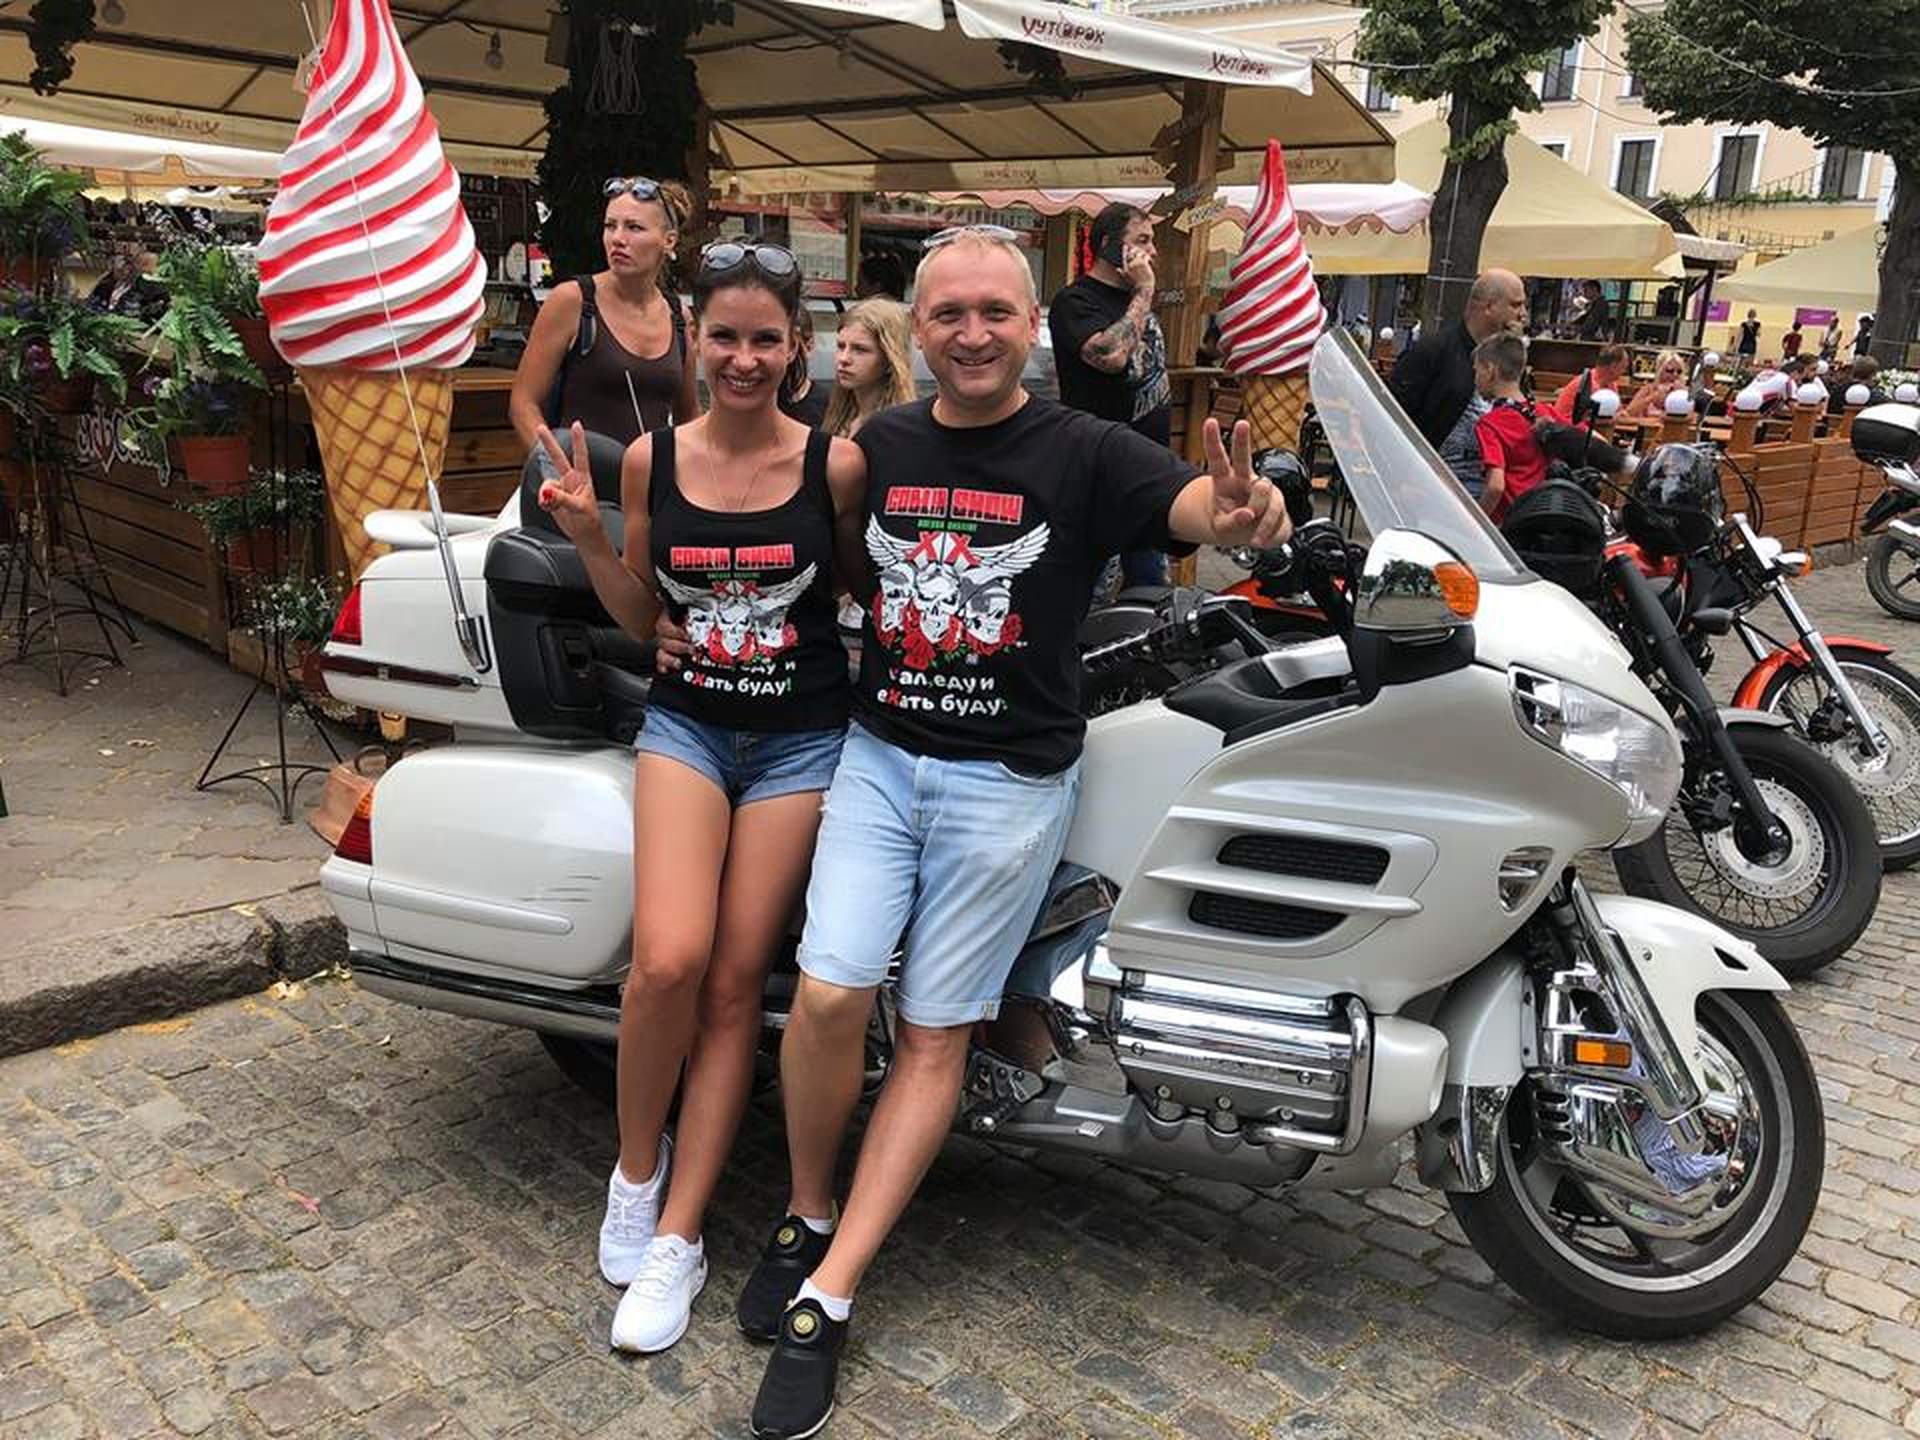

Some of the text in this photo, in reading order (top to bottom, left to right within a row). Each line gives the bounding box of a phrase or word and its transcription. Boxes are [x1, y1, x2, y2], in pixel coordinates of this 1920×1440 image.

[737, 677, 792, 697] буду!
[933, 674, 977, 694] еду
[980, 677, 996, 691] и
